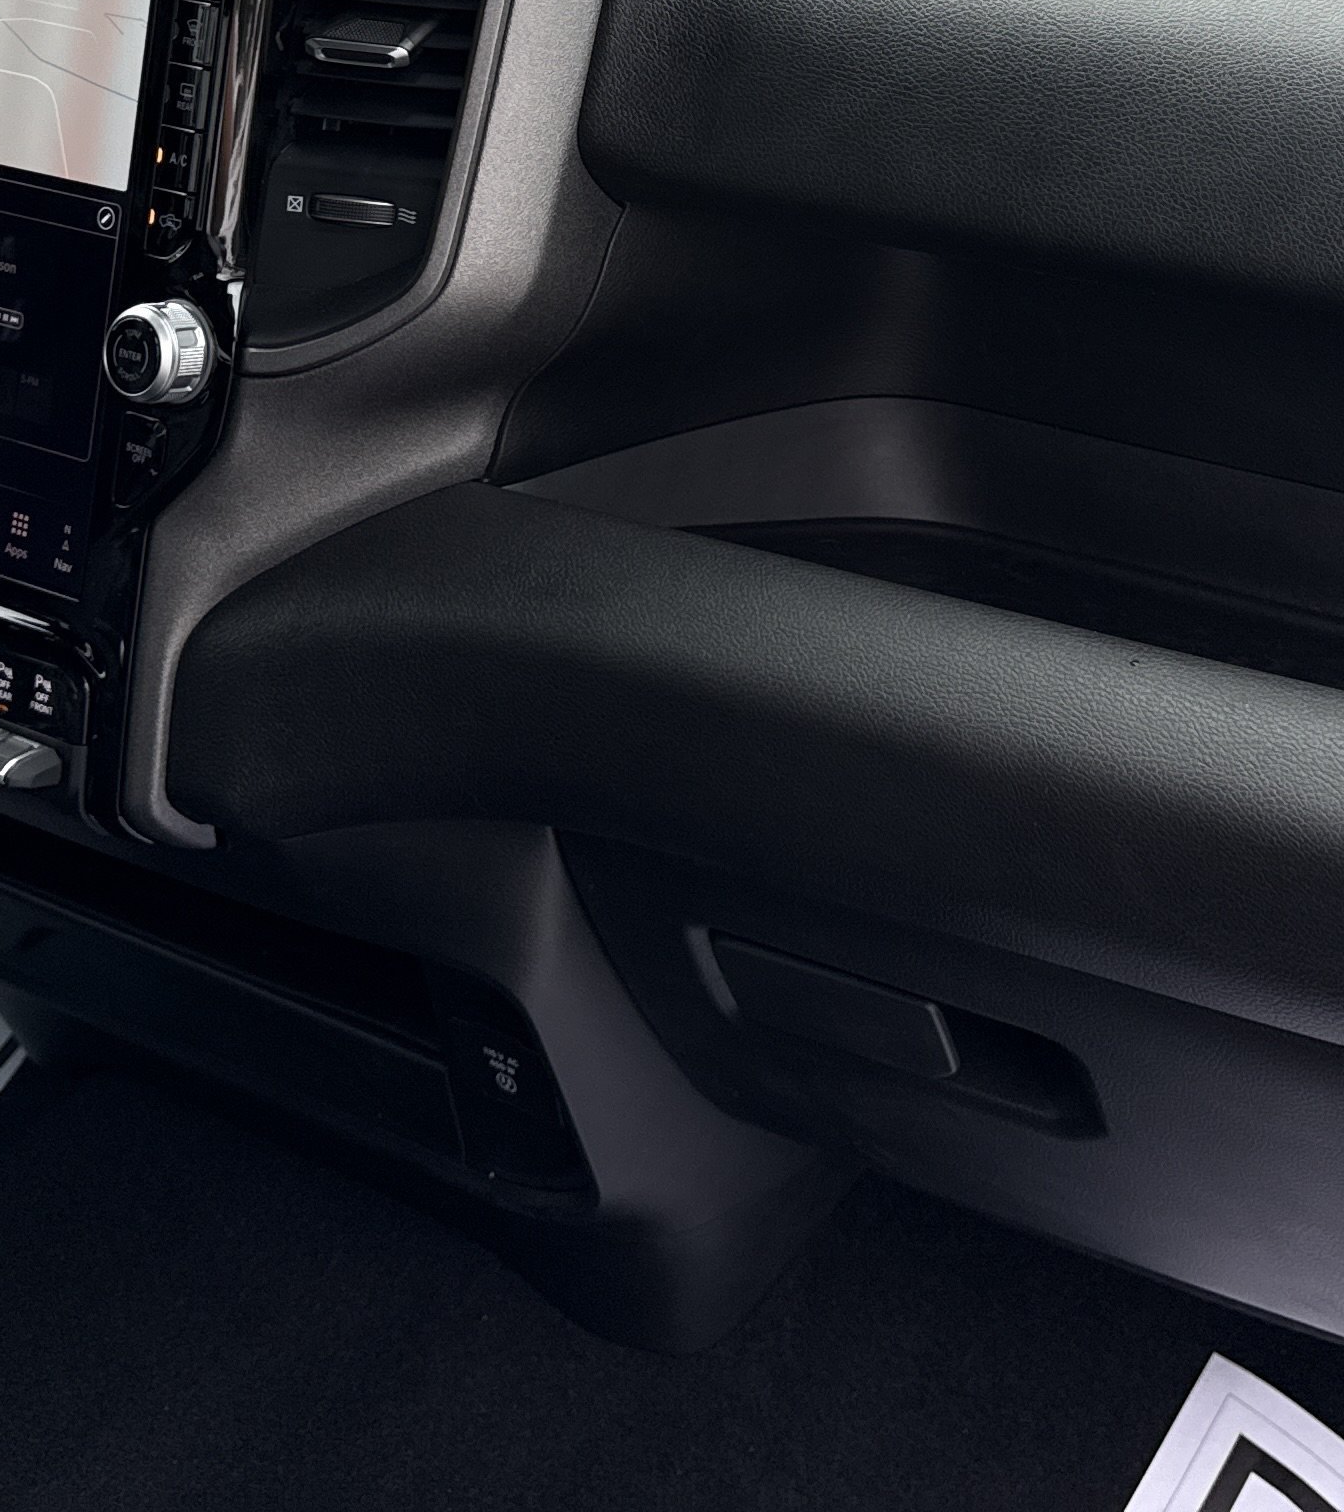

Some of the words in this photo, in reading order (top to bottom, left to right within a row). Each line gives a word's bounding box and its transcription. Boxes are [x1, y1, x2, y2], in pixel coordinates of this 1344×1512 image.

[169, 152, 188, 168] A/C
[118, 347, 142, 362] ENTER
[125, 441, 153, 459] SCREEN
[4, 542, 29, 561] Apps
[53, 557, 73, 574] Nav
